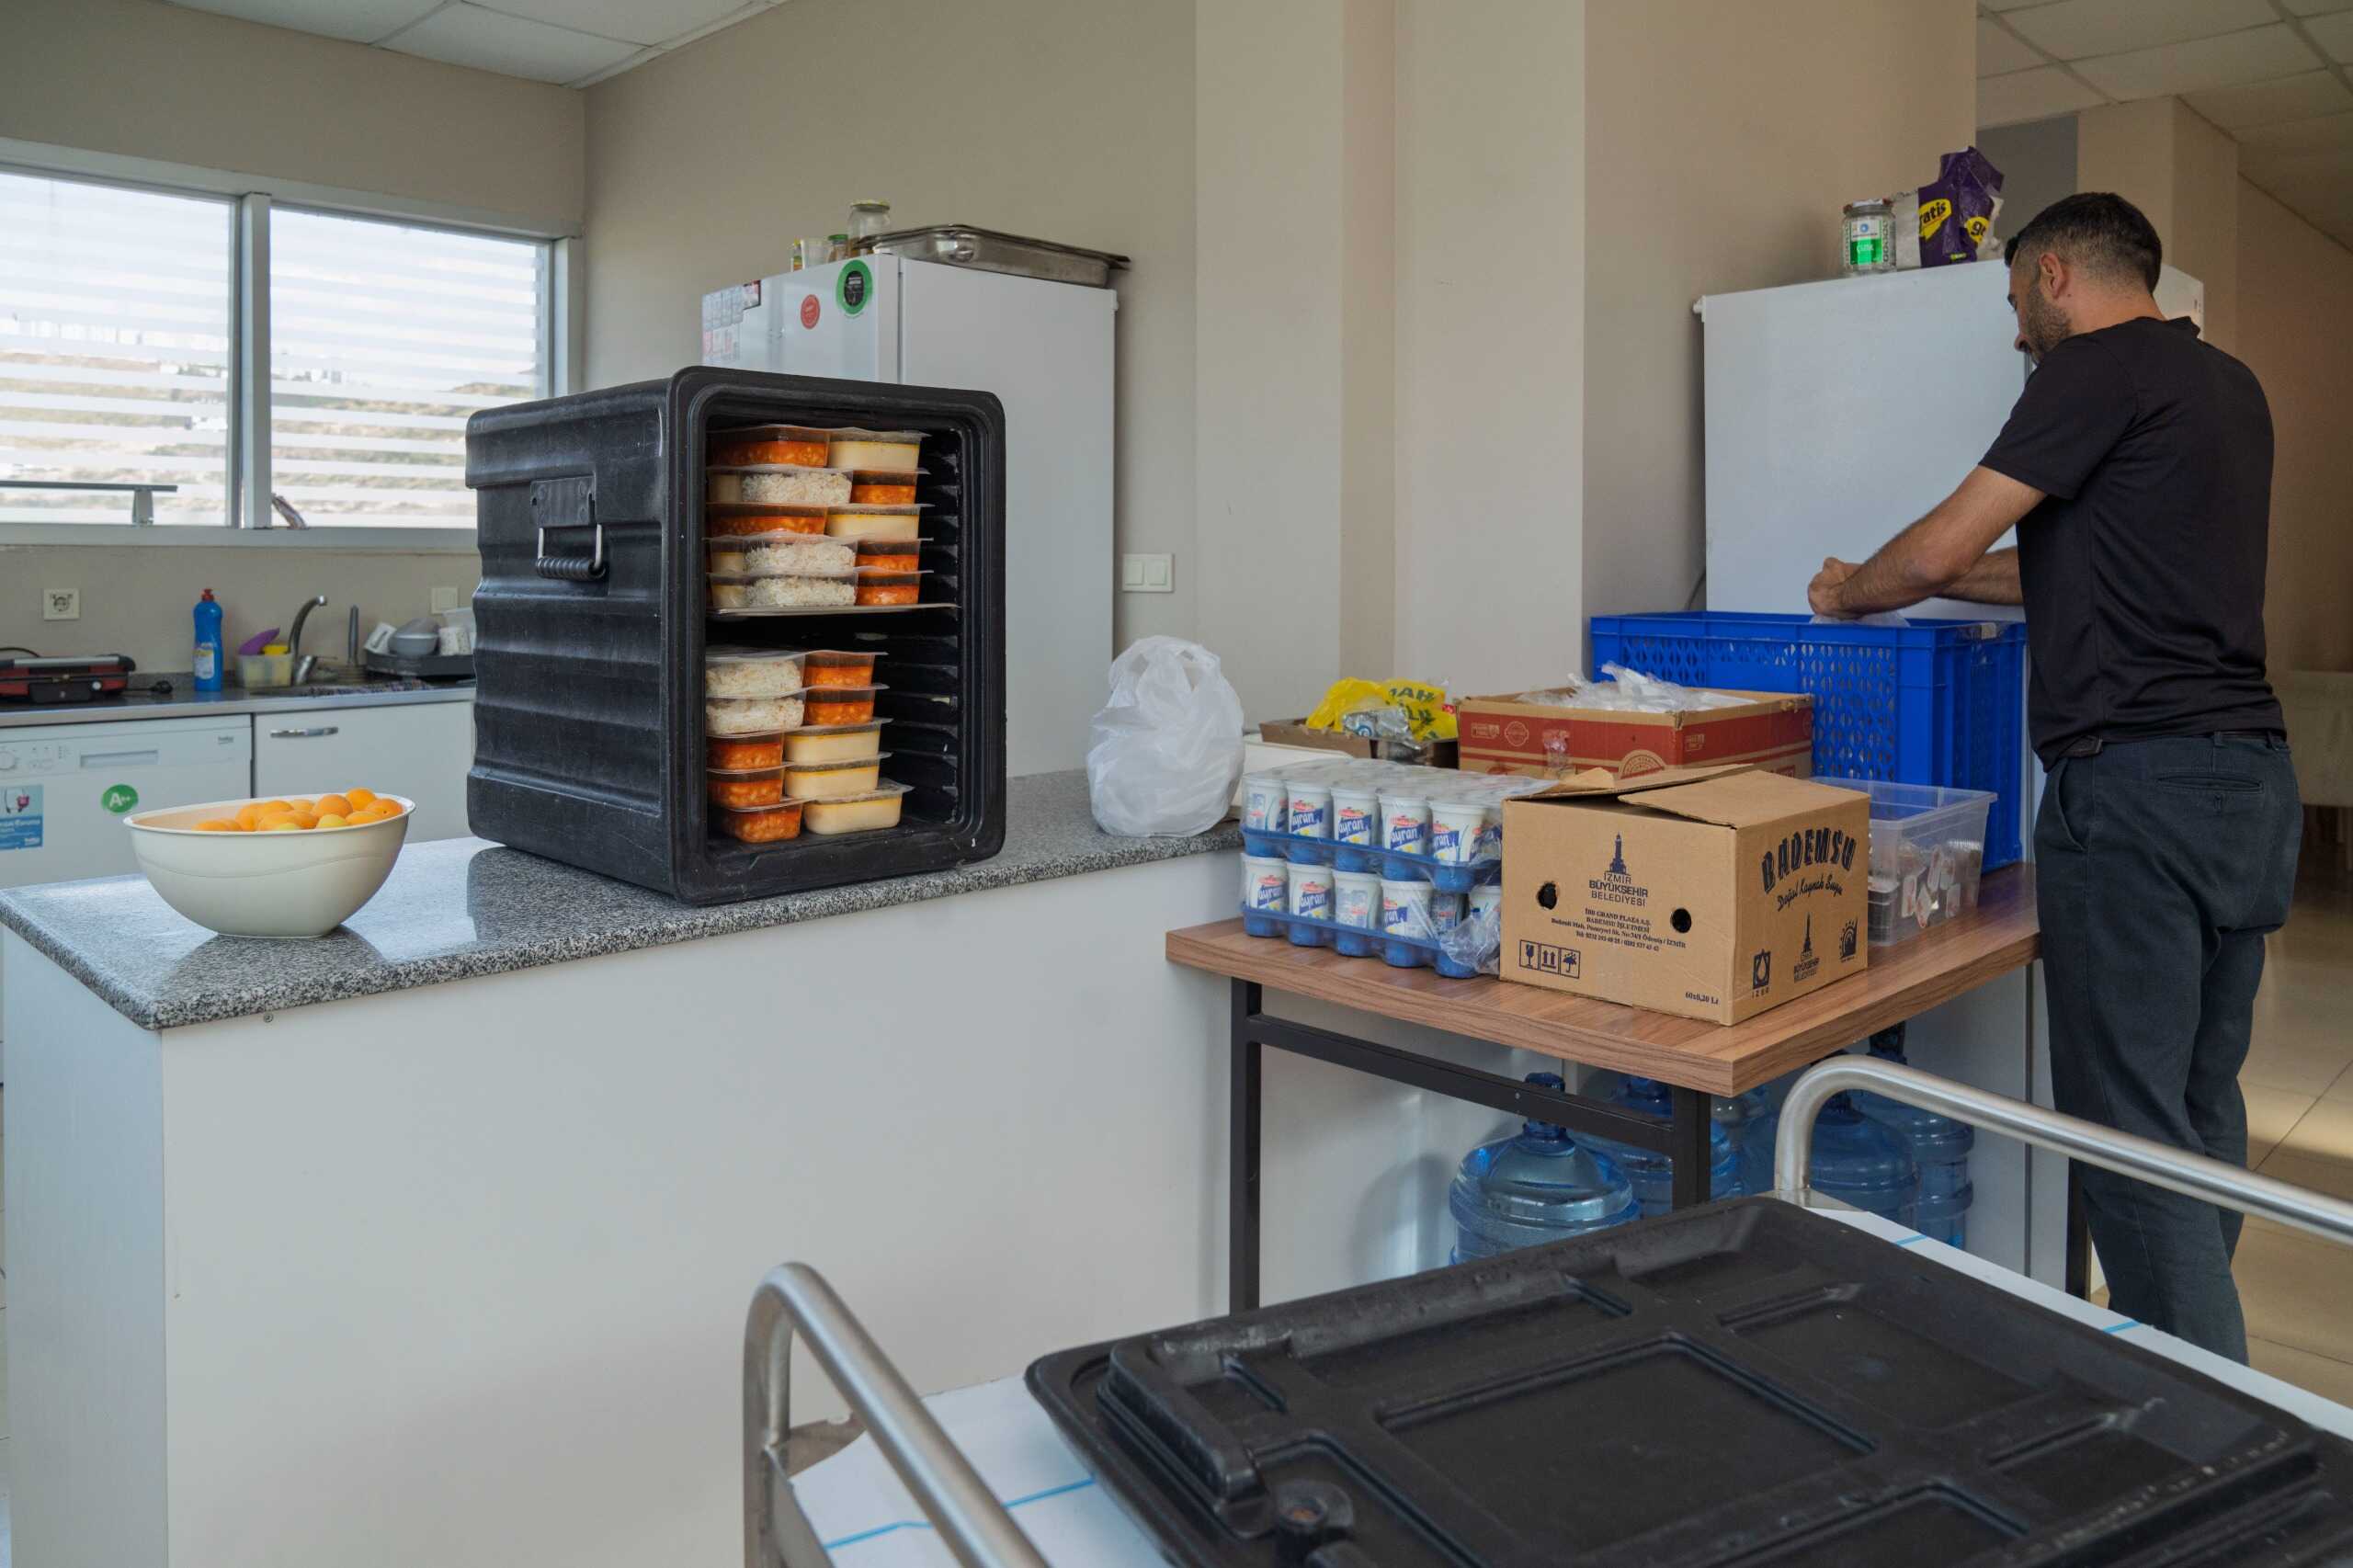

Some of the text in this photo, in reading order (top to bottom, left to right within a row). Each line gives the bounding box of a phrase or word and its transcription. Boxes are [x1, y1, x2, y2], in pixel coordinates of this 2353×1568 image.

[1918, 201, 1946, 226] ratis
[1338, 819, 1365, 835] ayran
[1391, 828, 1417, 844] ayran
[1761, 827, 1856, 894] BADEMSU
[1300, 893, 1324, 909] ayran
